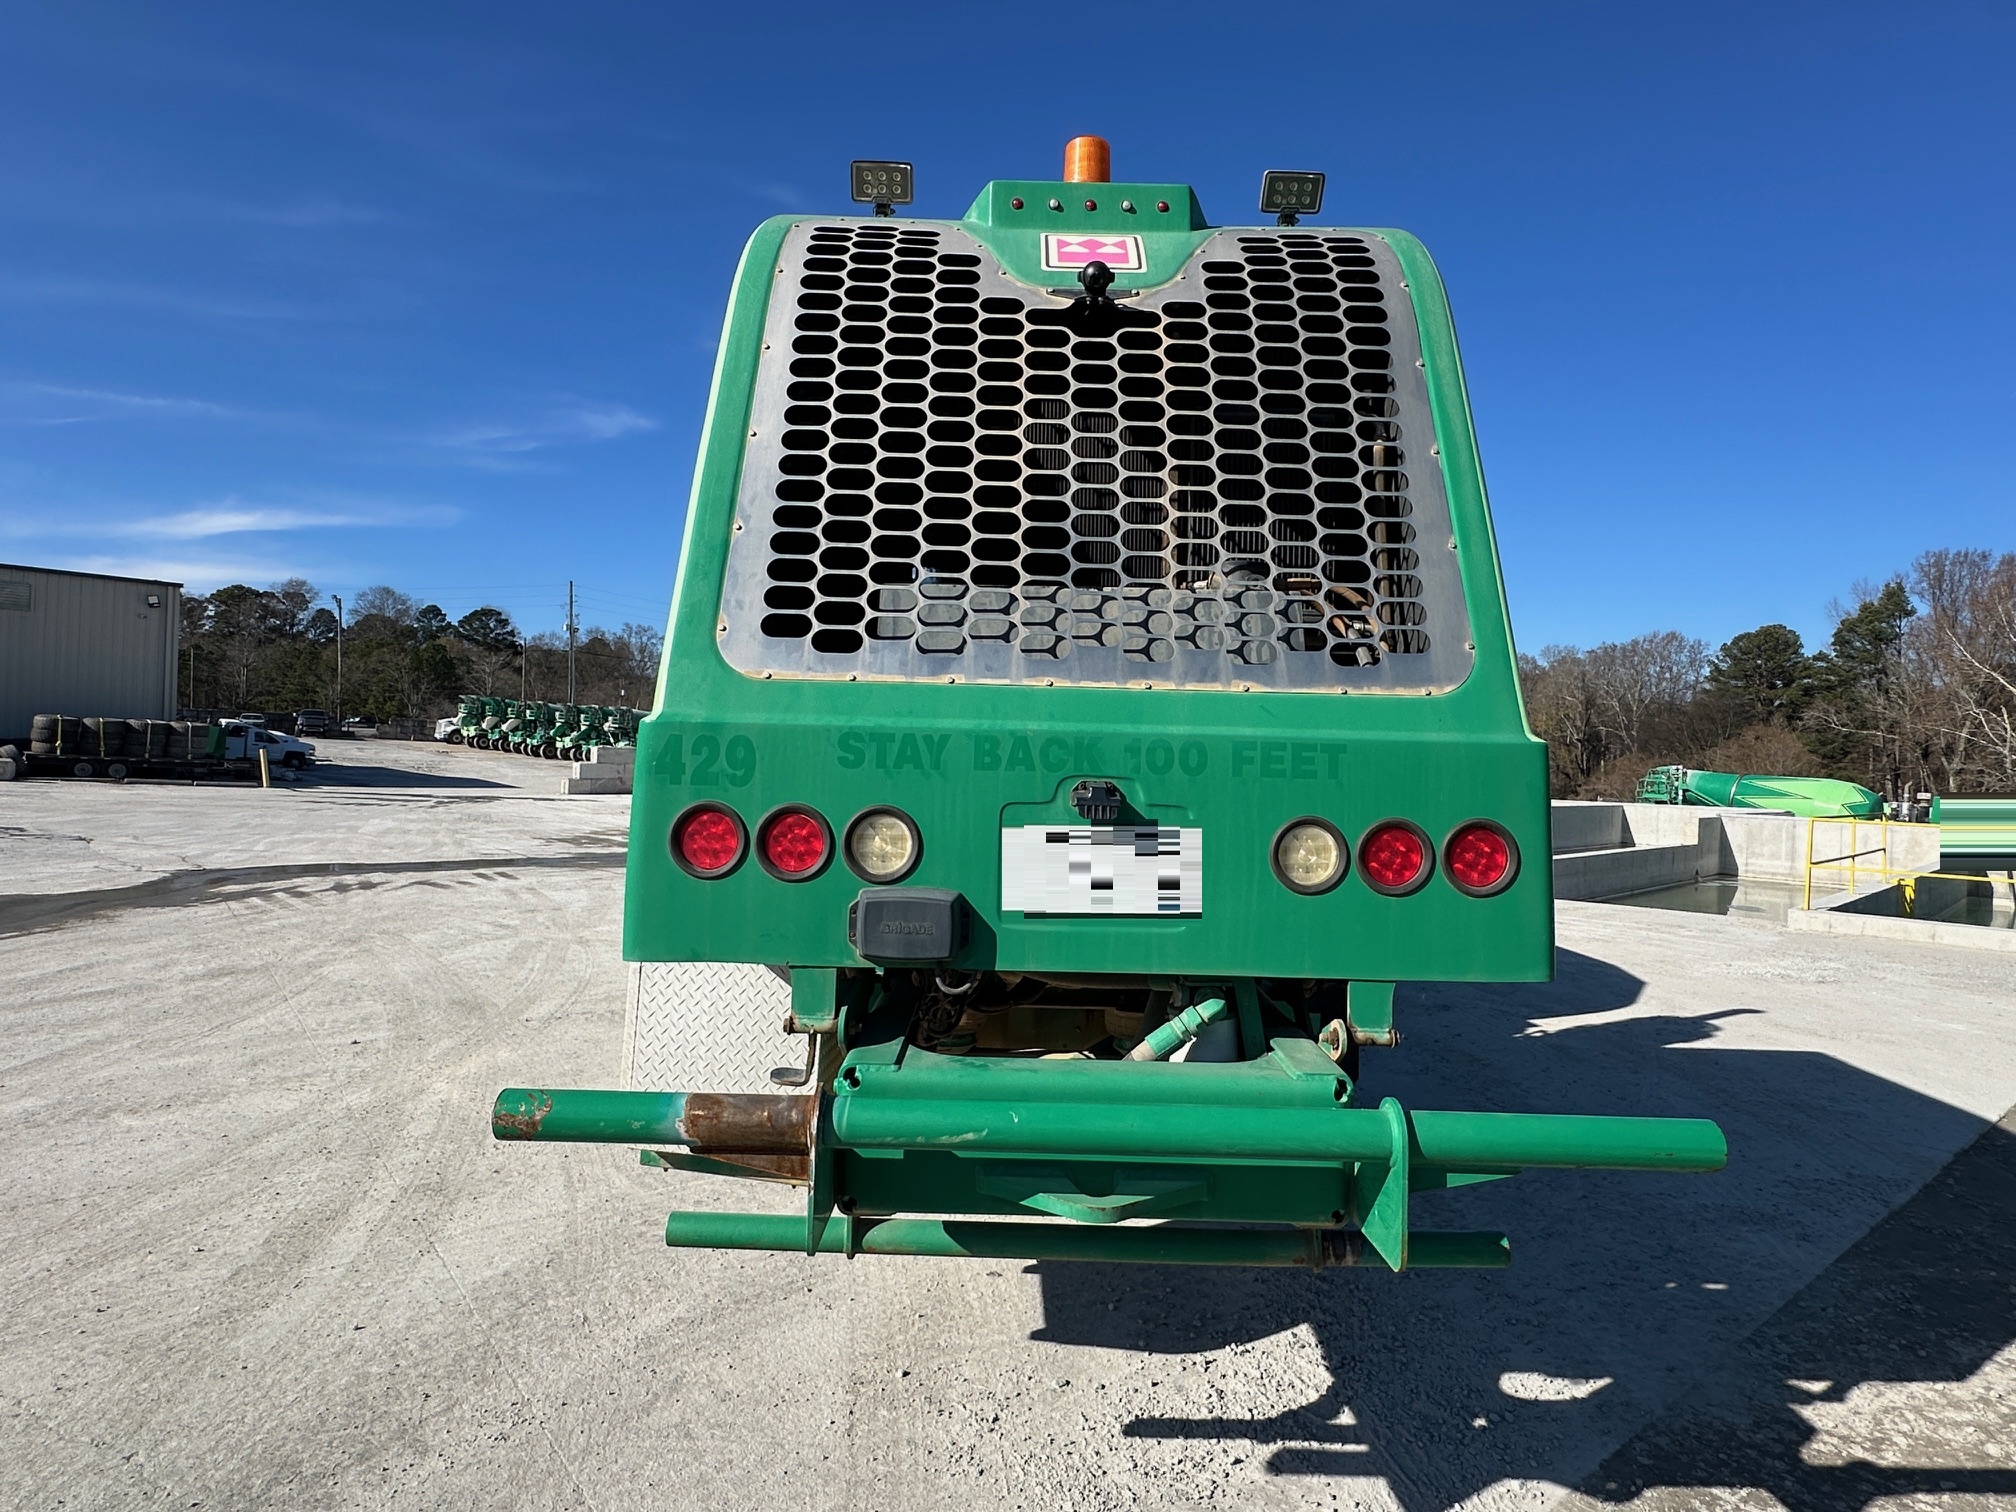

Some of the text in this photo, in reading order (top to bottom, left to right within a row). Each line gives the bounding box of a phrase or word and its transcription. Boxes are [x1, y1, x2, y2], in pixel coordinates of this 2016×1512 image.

[653, 734, 757, 788] 429
[836, 731, 1347, 780] STAY BACK 100 FEET
